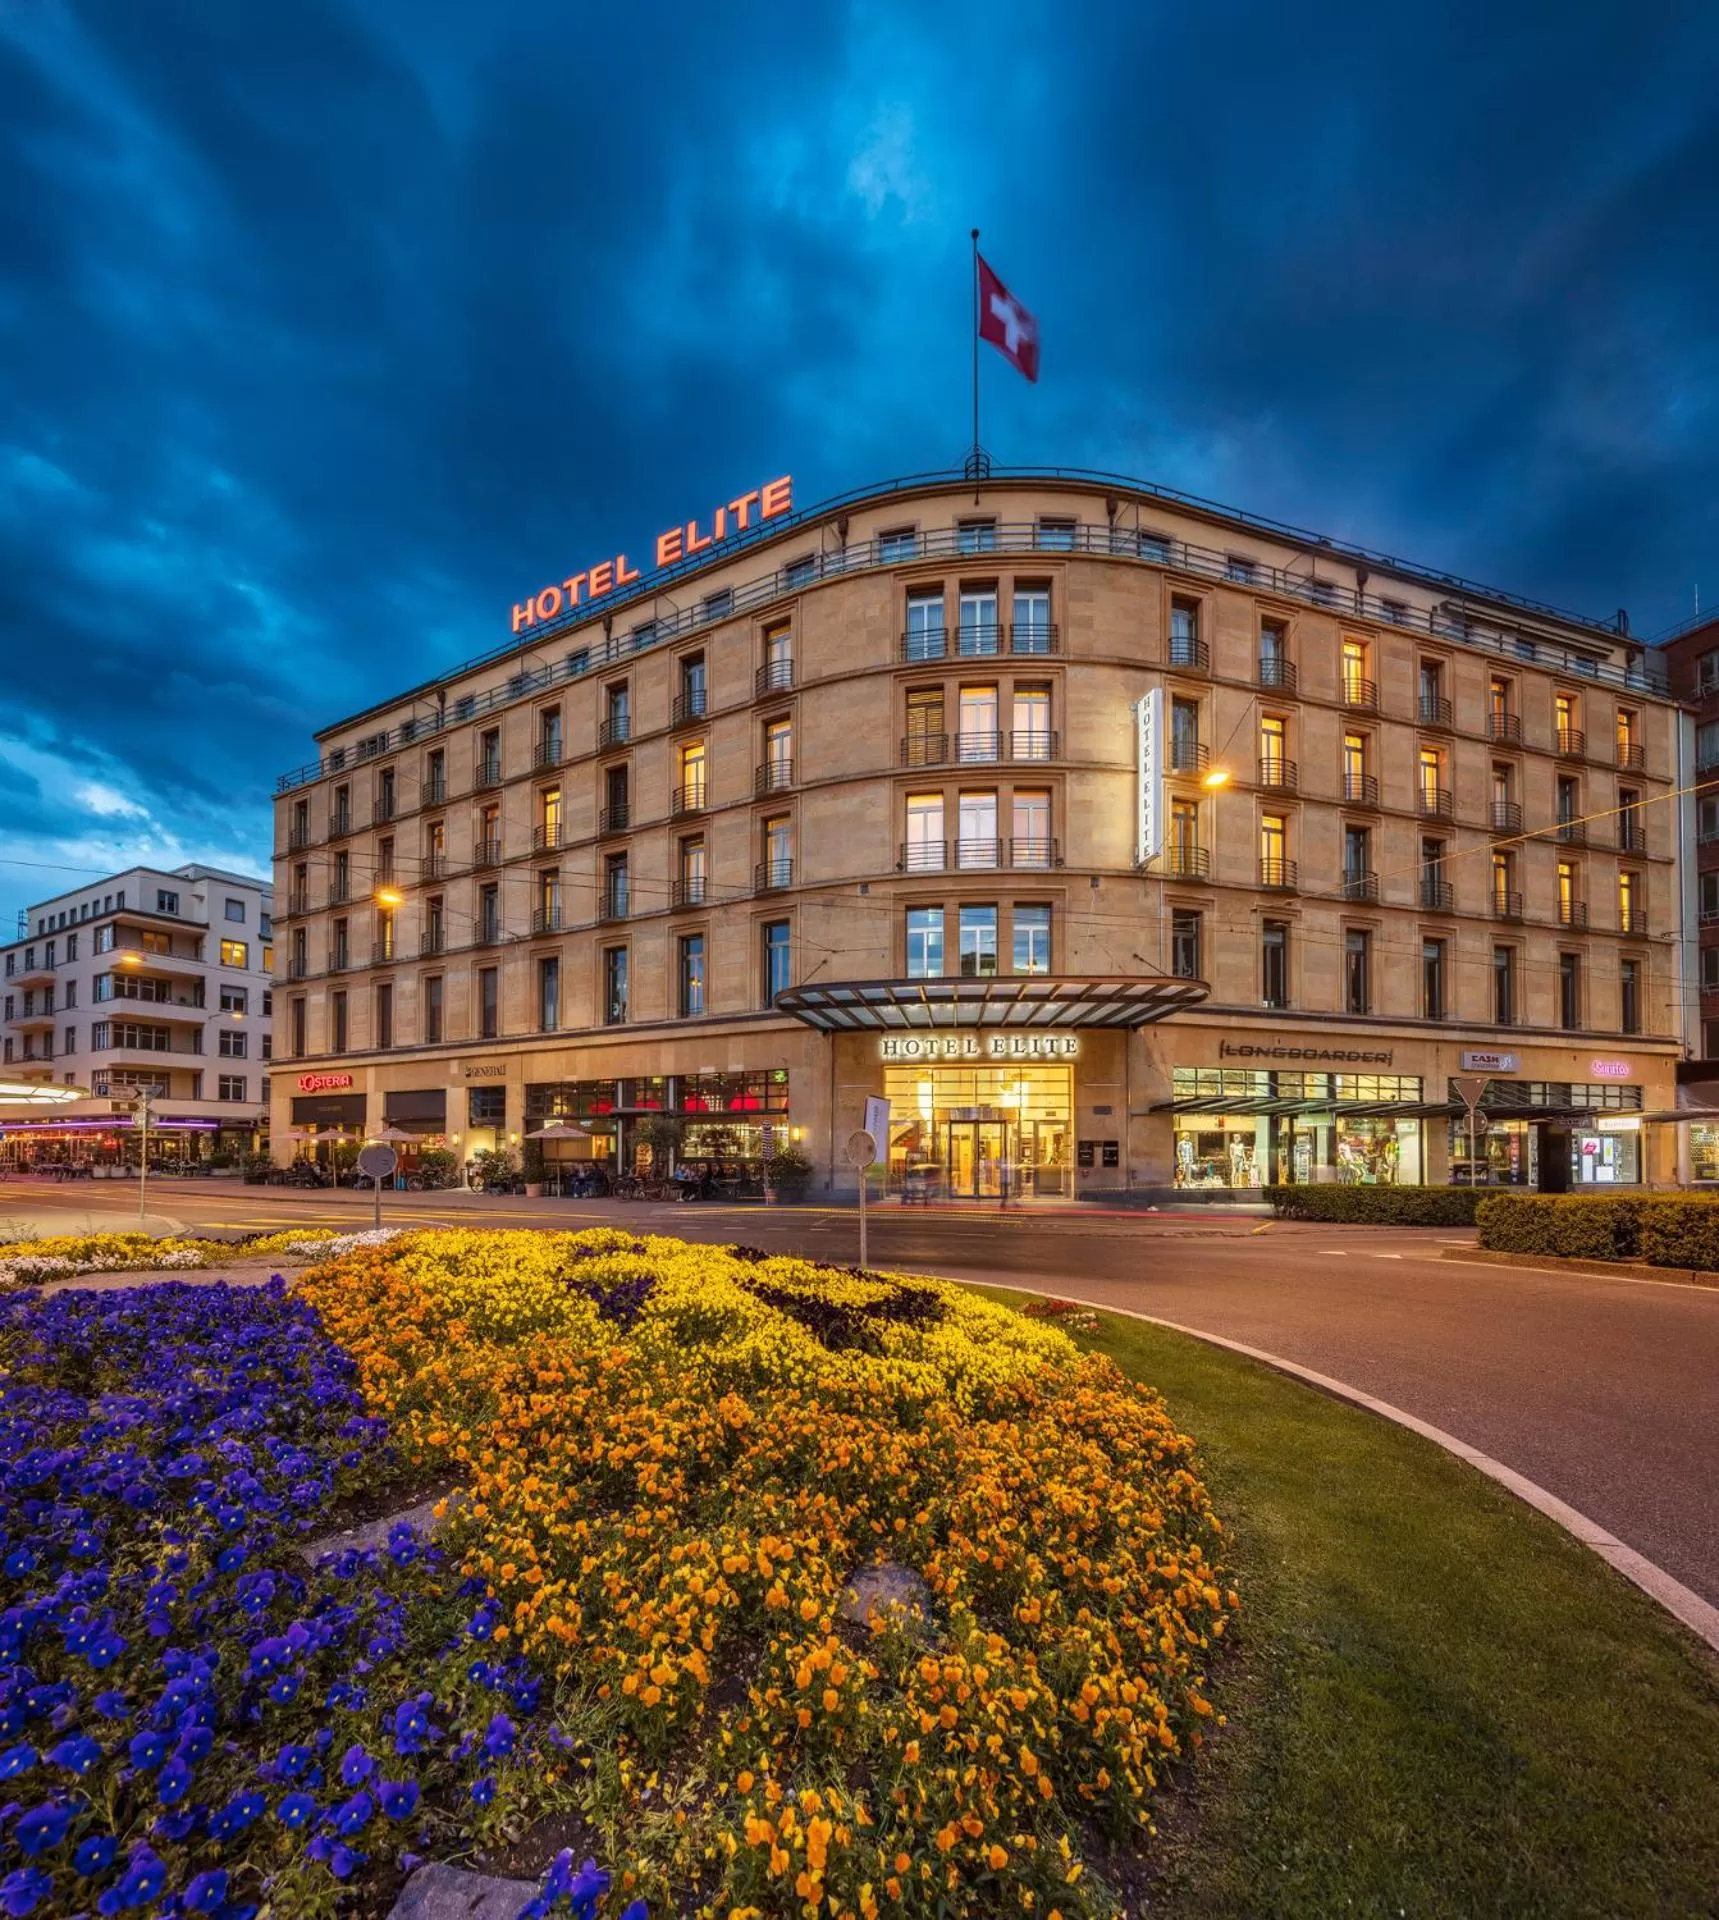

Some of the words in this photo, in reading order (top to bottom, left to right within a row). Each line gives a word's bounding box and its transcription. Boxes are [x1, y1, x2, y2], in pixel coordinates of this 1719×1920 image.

[511, 554, 640, 634] HOTEL
[655, 474, 793, 568] ELITE
[1143, 696, 1151, 774] HOTEL
[1143, 781, 1151, 858] ELITE
[881, 1038, 979, 1057] HOTEL
[991, 1037, 1079, 1055] ELITE
[1223, 1044, 1389, 1064] LONGBOARDER
[1471, 1055, 1500, 1064] CASH
